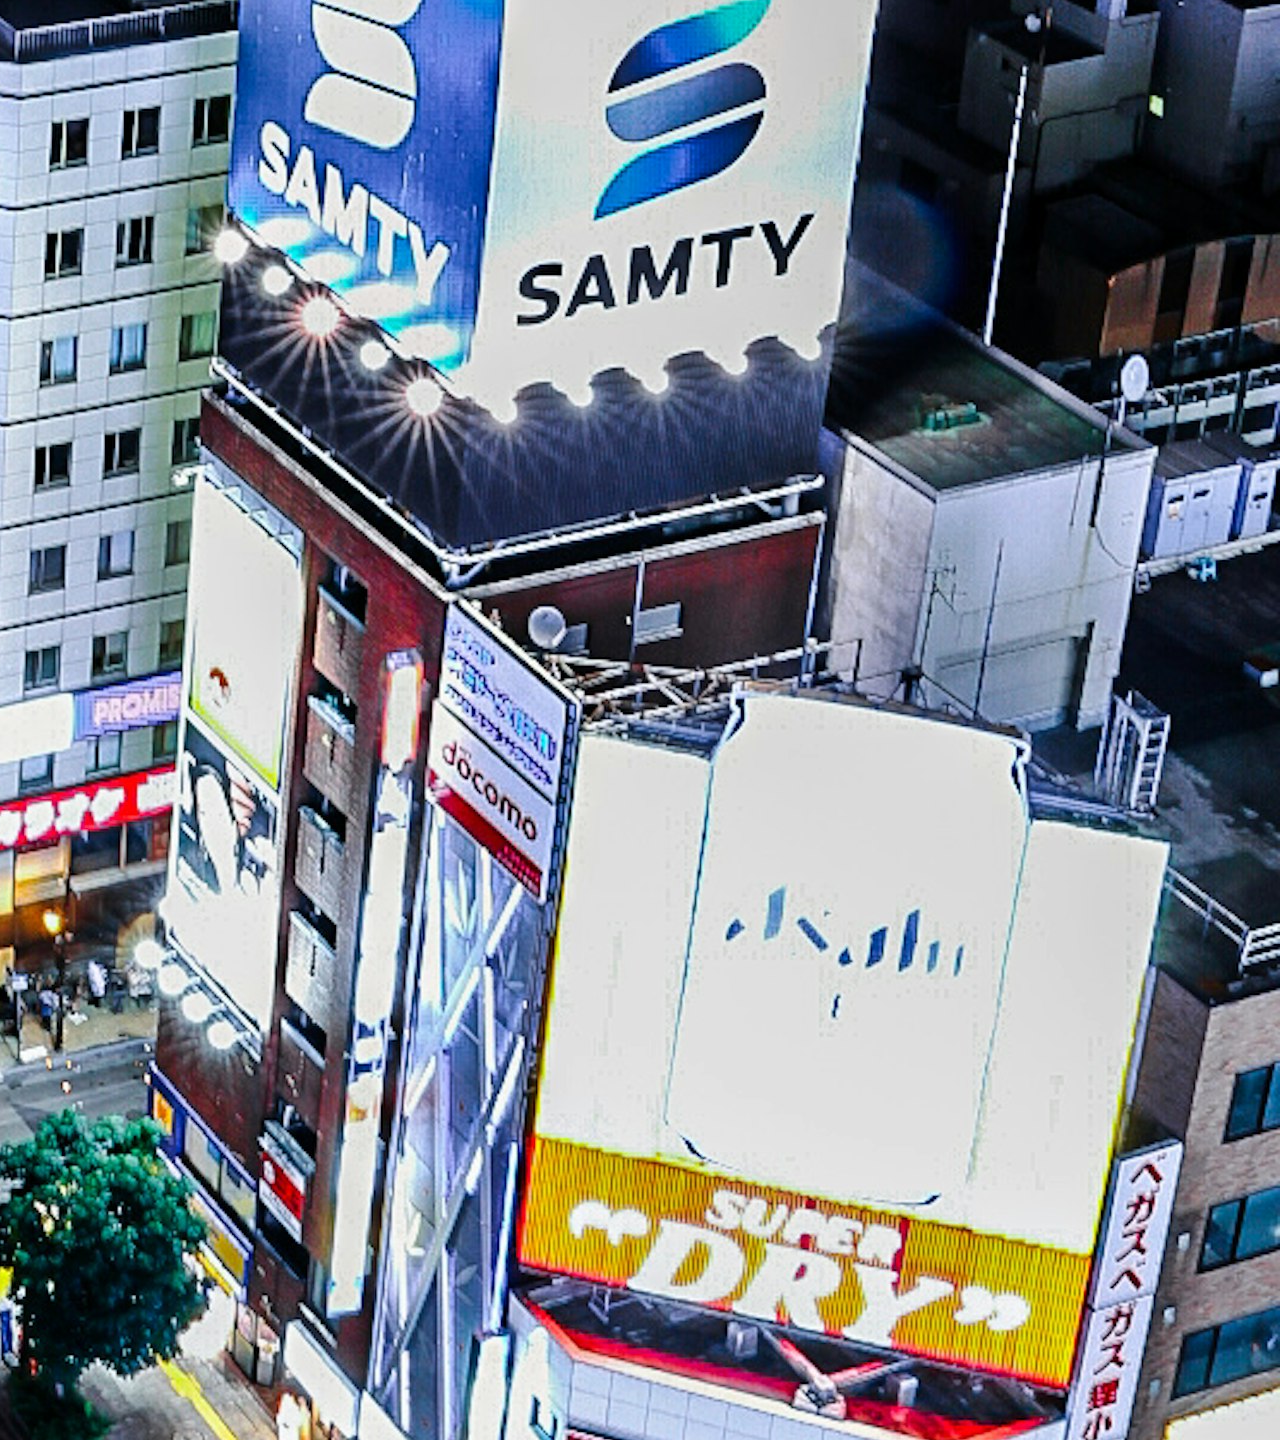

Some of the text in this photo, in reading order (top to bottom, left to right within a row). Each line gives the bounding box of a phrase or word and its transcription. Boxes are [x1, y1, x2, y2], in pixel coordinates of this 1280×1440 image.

[258, 121, 449, 309] SAMTY
[516, 212, 815, 326] SAMTY
[443, 742, 538, 842] docomo
[708, 1190, 903, 1266] SUPER
